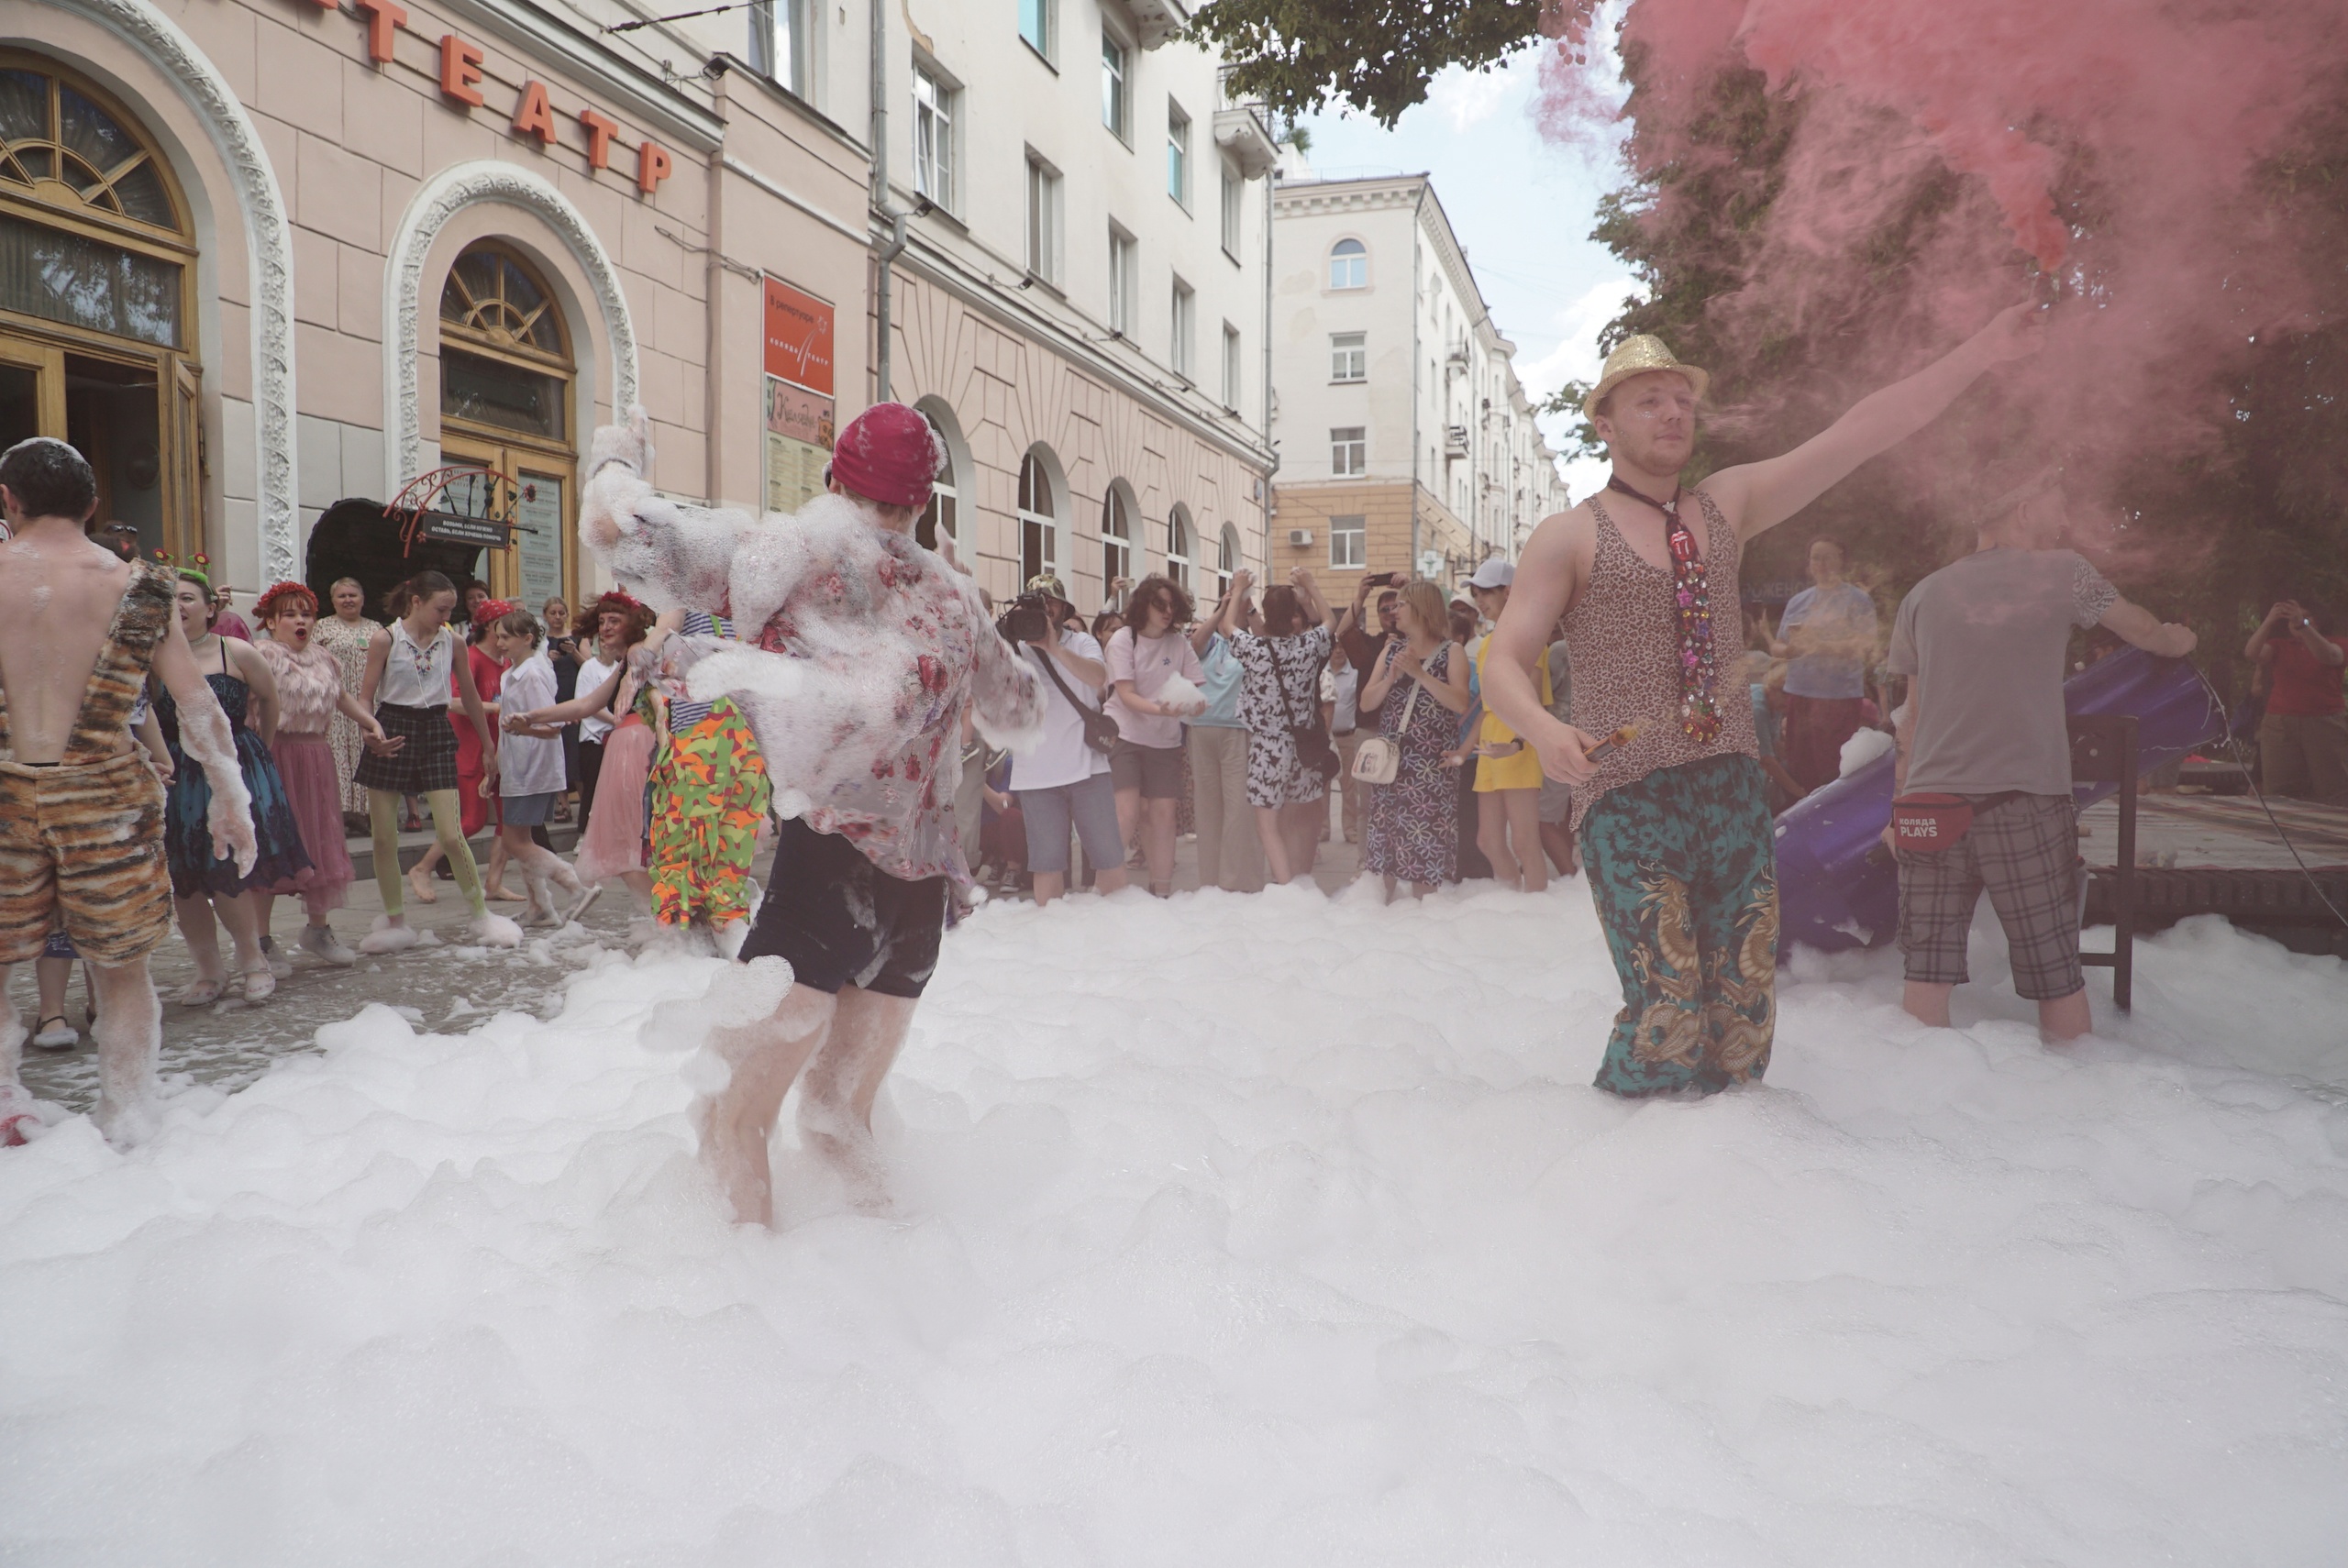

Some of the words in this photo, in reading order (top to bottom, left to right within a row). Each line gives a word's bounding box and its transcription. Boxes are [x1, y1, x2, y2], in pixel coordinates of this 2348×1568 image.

[357, 0, 672, 194] ТЕАТР
[1899, 818, 1936, 826] коляда
[1900, 826, 1938, 837] PLAYS
